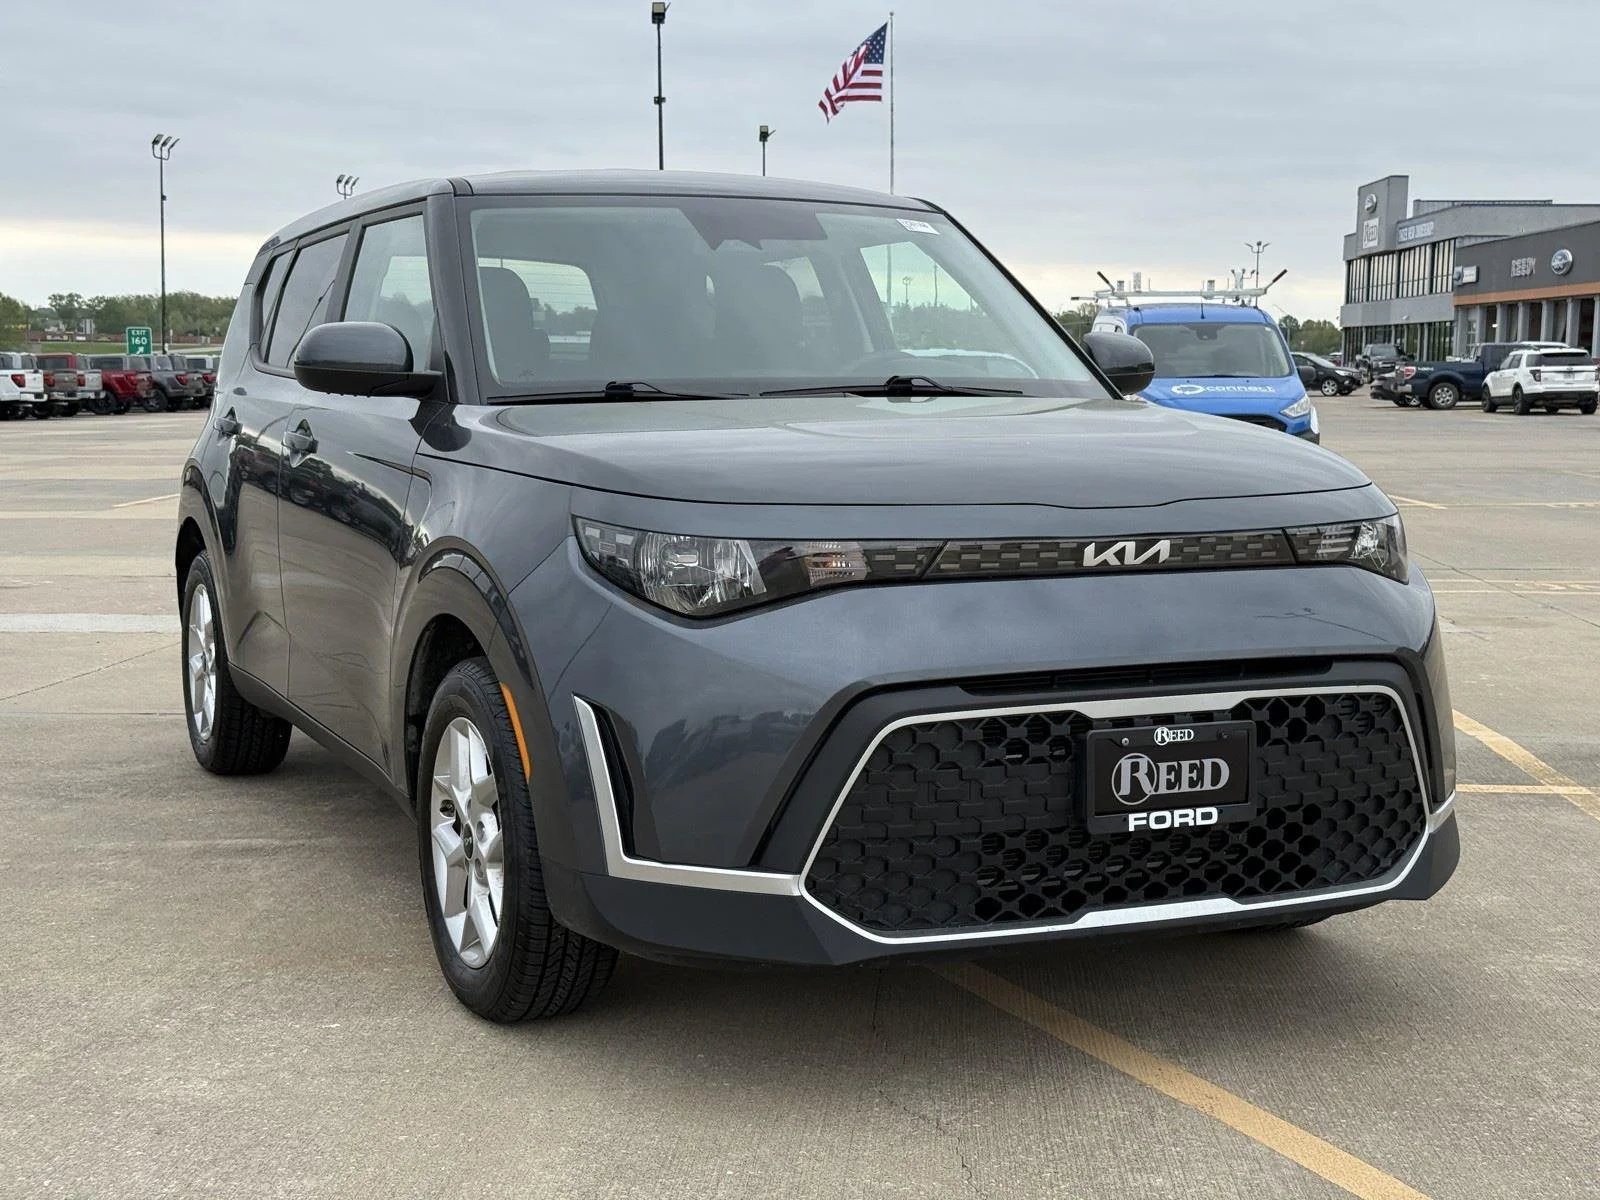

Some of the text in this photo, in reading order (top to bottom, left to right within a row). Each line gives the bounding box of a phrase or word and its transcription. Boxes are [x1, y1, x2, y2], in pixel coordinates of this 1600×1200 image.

[131, 336, 148, 345] 160
[1082, 539, 1171, 567] KIA
[1154, 726, 1195, 746] REED
[1112, 754, 1230, 804] REED
[1128, 806, 1218, 832] FORD
